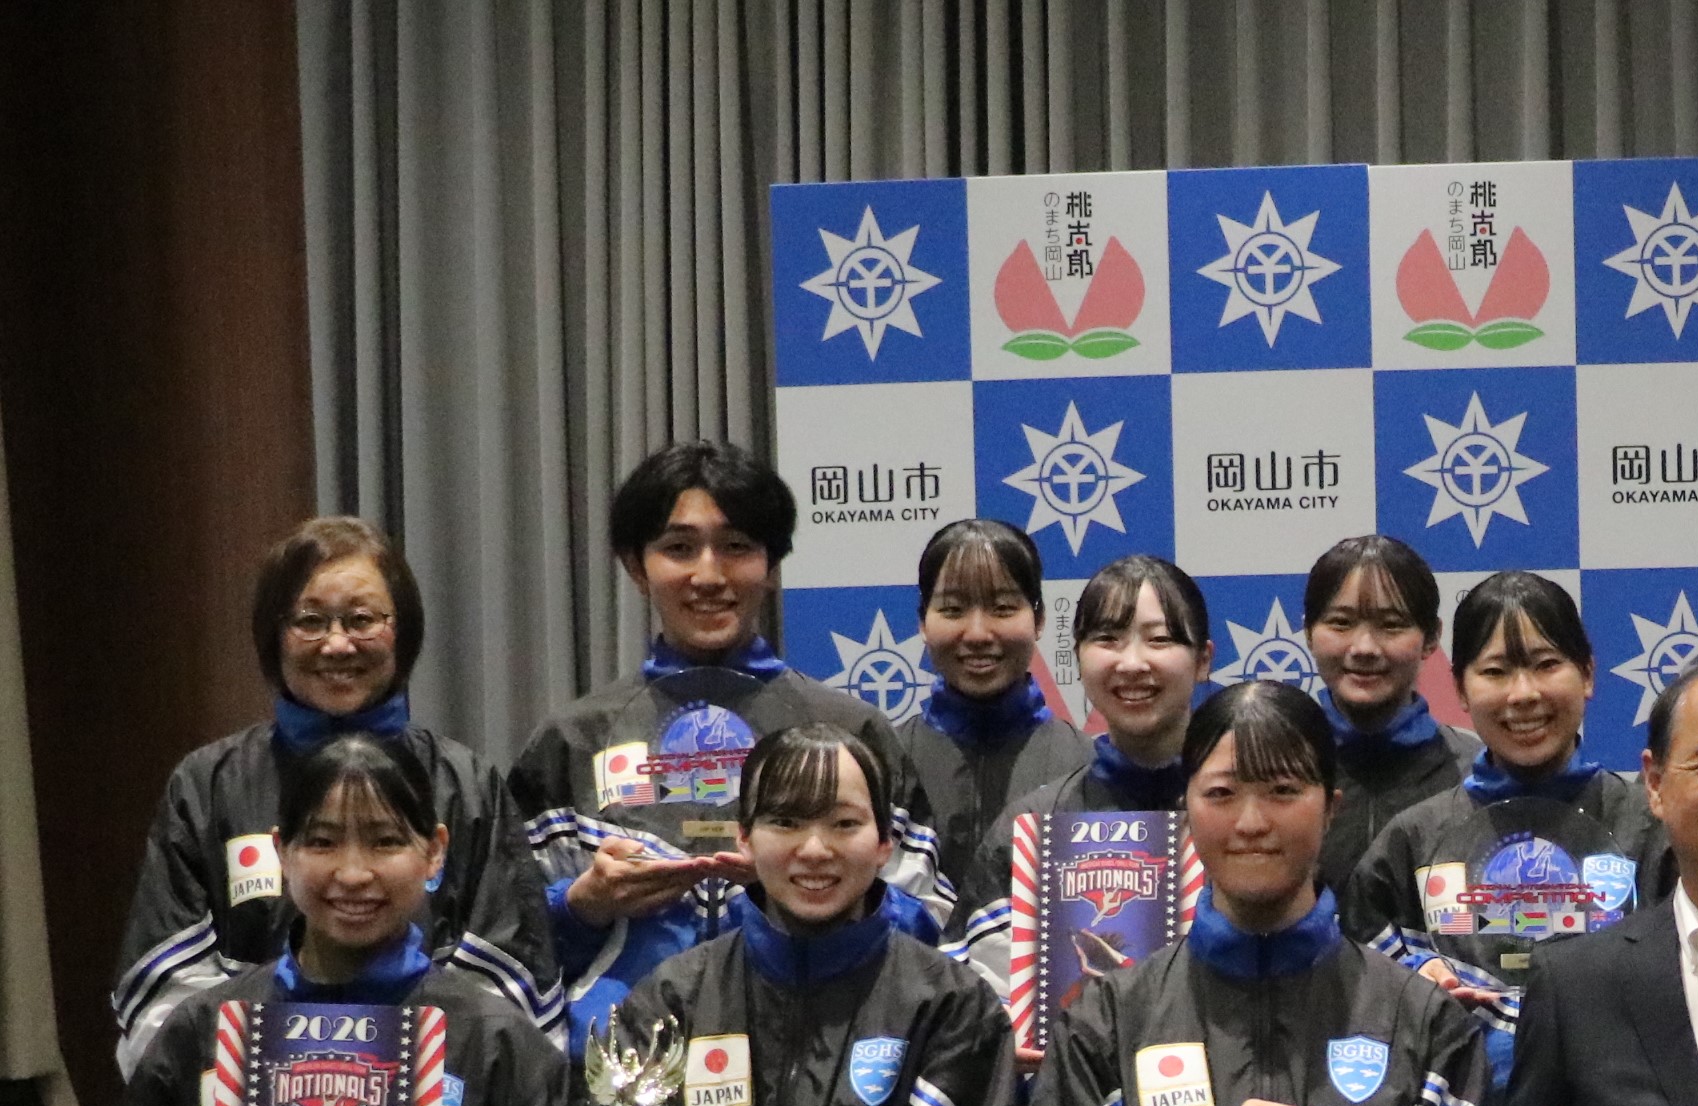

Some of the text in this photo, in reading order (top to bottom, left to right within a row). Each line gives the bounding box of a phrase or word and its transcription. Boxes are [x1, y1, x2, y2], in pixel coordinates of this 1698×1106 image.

[1044, 192, 1061, 281] のまち岡山
[1066, 191, 1093, 279] 桃太郎
[1447, 182, 1465, 270] のまち岡山
[1470, 181, 1497, 270] 桃太郎
[811, 462, 942, 505] 岡山市
[1206, 450, 1341, 492] 岡山市
[1206, 494, 1339, 511] OKAYAMA CITY
[1612, 489, 1698, 504] OKAYAMA
[811, 507, 940, 524] OKAYAMA CITY
[1054, 597, 1072, 685] のまち岡山
[1071, 820, 1148, 843] 2026
[1585, 859, 1631, 874] SGHS
[231, 877, 275, 900] JAPAN
[1066, 869, 1153, 897] NATIONALS
[1456, 891, 1606, 904] COMPETITION
[285, 1014, 378, 1042] 2026
[853, 1044, 903, 1060] SGHS
[1333, 1044, 1383, 1061] SGHS
[278, 1073, 382, 1106] NATIONALS
[692, 1085, 743, 1106] JAPAN
